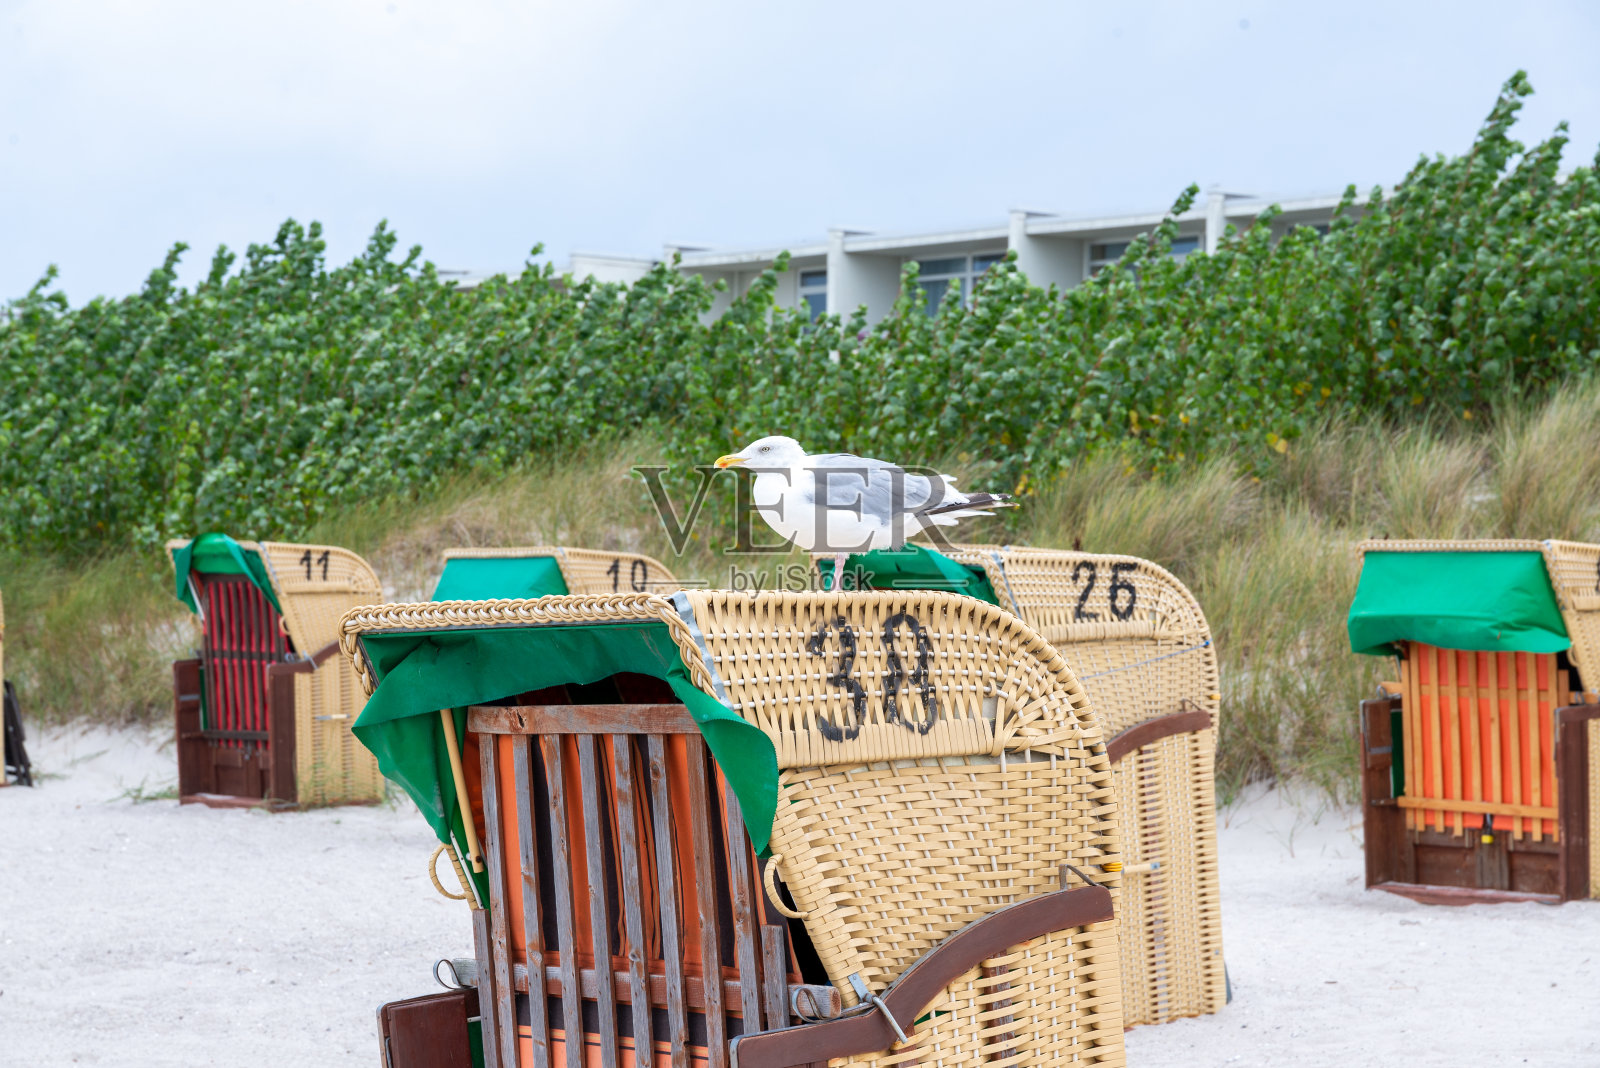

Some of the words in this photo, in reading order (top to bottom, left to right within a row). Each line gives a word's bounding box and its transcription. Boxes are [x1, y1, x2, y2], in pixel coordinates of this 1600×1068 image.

[300, 549, 330, 581] 11
[607, 558, 647, 593] 10
[1071, 560, 1138, 621] 26
